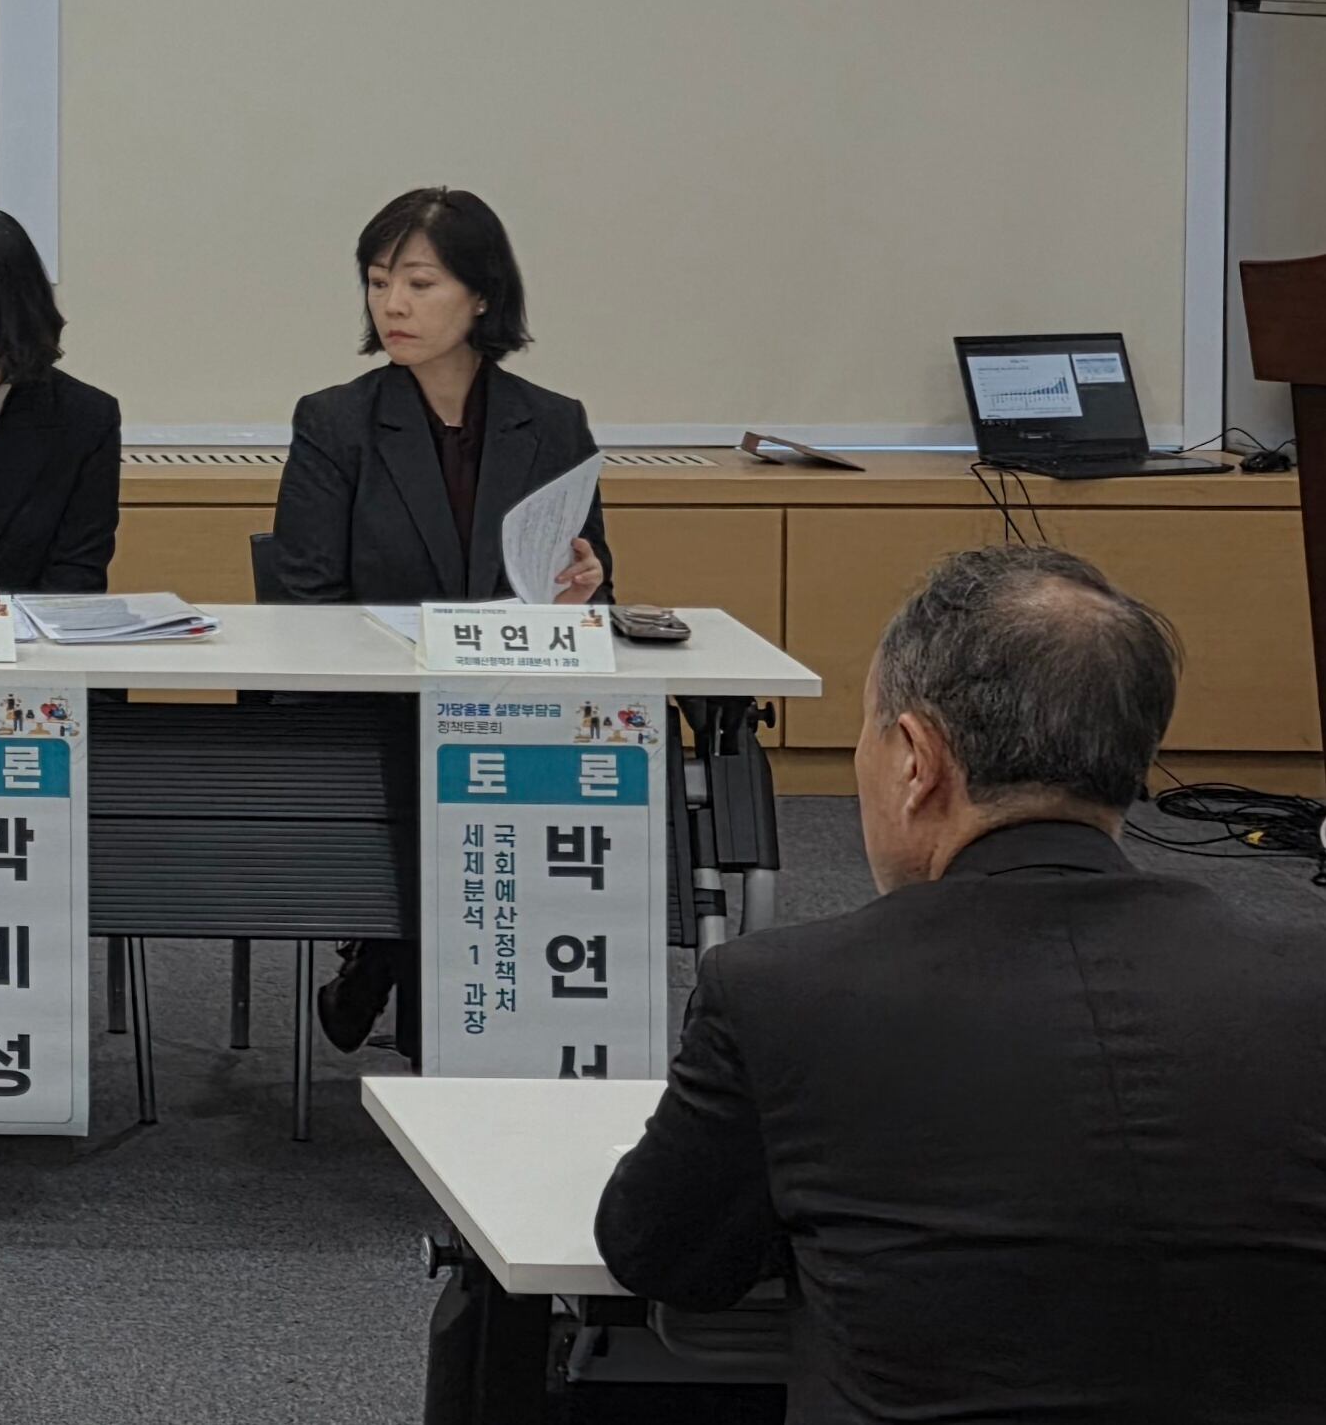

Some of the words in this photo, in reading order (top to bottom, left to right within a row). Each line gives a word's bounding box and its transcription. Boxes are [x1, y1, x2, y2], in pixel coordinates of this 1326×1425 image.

[437, 702, 491, 717] 가당음료
[494, 703, 562, 718] 설탕부담금
[437, 720, 502, 735] 정책토론회
[462, 824, 485, 930] 세제분석
[494, 824, 518, 1013] 국회예산정책처
[469, 944, 479, 965] 1
[464, 983, 488, 1035] 과장
